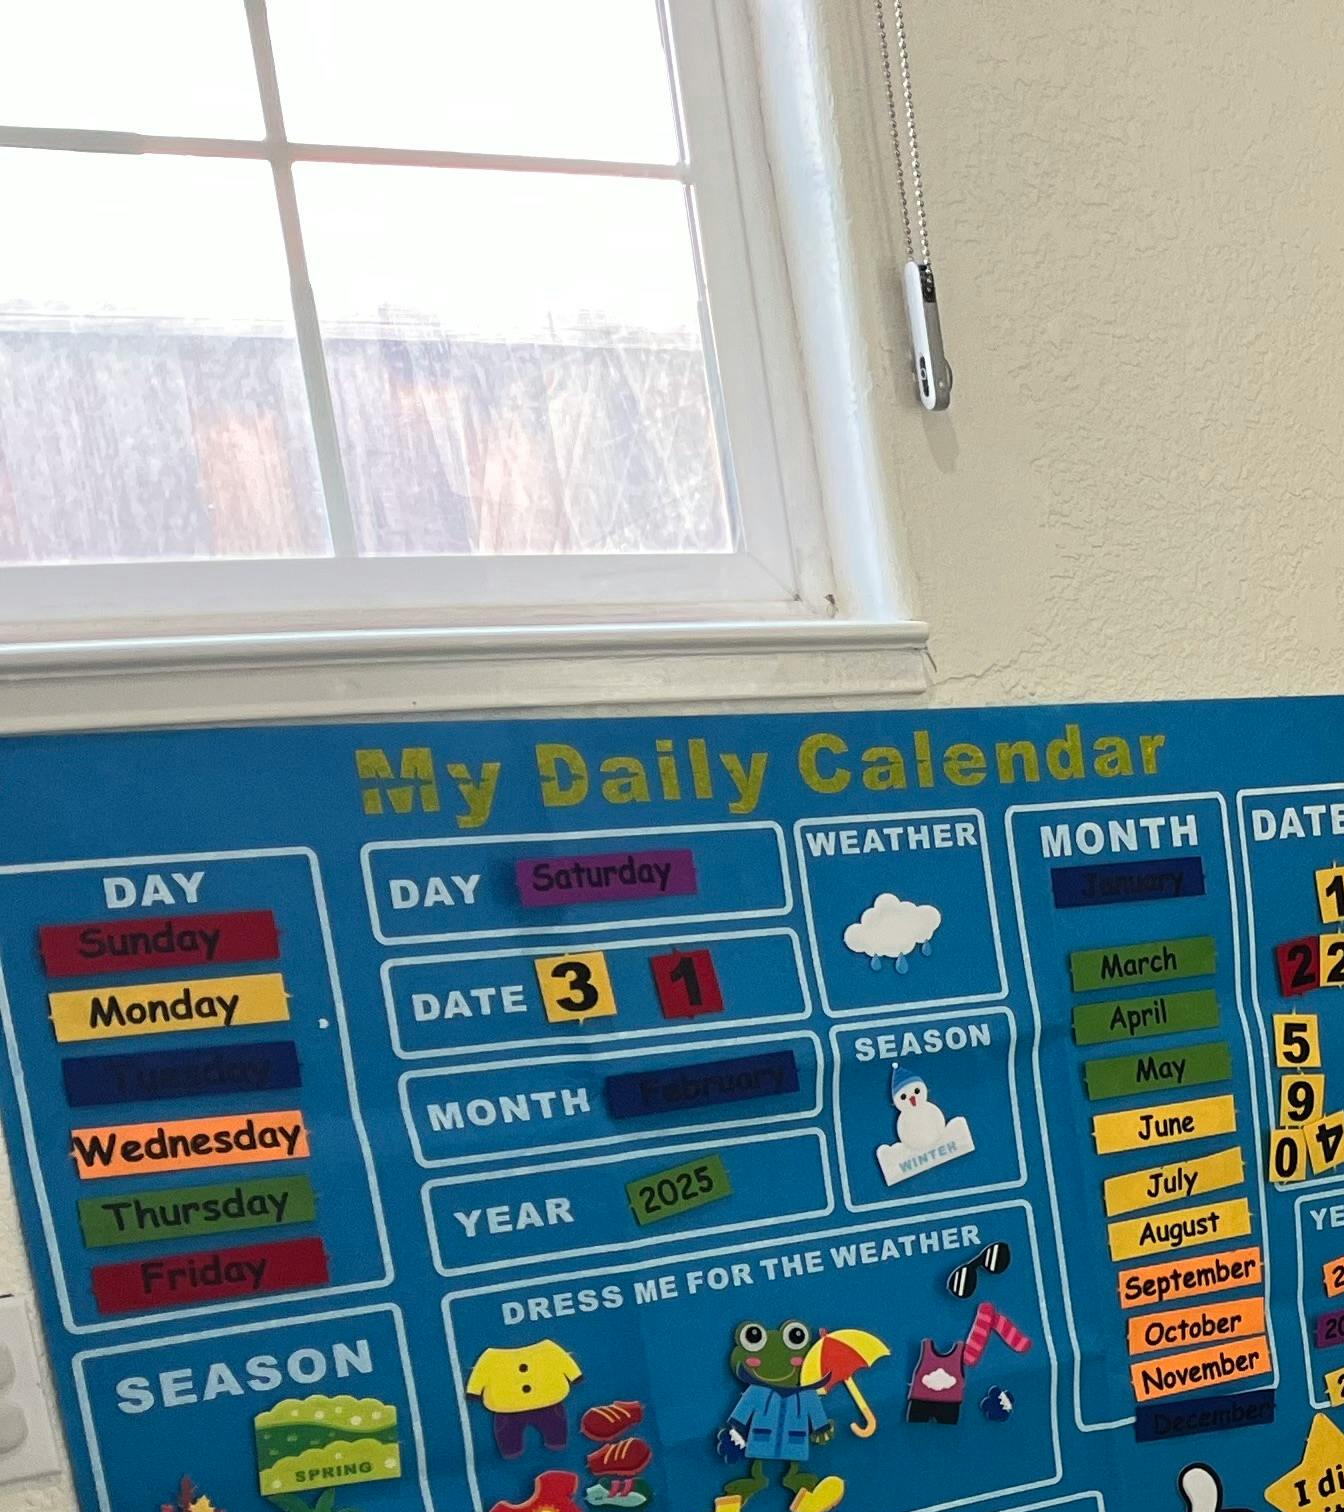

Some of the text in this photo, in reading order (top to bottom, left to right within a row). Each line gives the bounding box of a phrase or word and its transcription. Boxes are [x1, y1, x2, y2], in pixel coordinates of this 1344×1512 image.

[355, 725, 1166, 828] My Daily Calendar
[806, 821, 977, 859] WEATHER
[1040, 814, 1199, 859] MONTH
[103, 871, 205, 909] DAY
[389, 859, 673, 909] DAY Saturday
[1082, 869, 1185, 899] January
[79, 921, 222, 963] Sunday
[1100, 948, 1178, 979] March
[1286, 944, 1315, 988] 2
[412, 957, 703, 1021] DATE 3 1
[90, 991, 240, 1031] Monday
[1109, 1000, 1168, 1030] April
[854, 1022, 992, 1063] SEASON
[1283, 1023, 1310, 1063] 5
[1135, 1055, 1186, 1083] May
[427, 1060, 785, 1131] MONTH February
[72, 1119, 302, 1167] Wednesday
[1136, 1111, 1195, 1140] June
[899, 1141, 958, 1174] WINTER
[1275, 1137, 1298, 1178] 0
[454, 1166, 715, 1238] YEAR 2025
[1145, 1167, 1199, 1198] July
[102, 1187, 289, 1234] Thursday
[1138, 1210, 1220, 1249] August
[140, 1254, 268, 1294] Friday
[502, 1224, 981, 1327] DRESS ME FOR THE WEATHER
[1123, 1256, 1257, 1304] September
[1144, 1311, 1243, 1347] October
[116, 1339, 374, 1414] SEASON
[1141, 1350, 1260, 1396] November
[1153, 1399, 1270, 1434] December
[295, 1460, 374, 1485] SPRING
[1293, 1478, 1310, 1508] I
